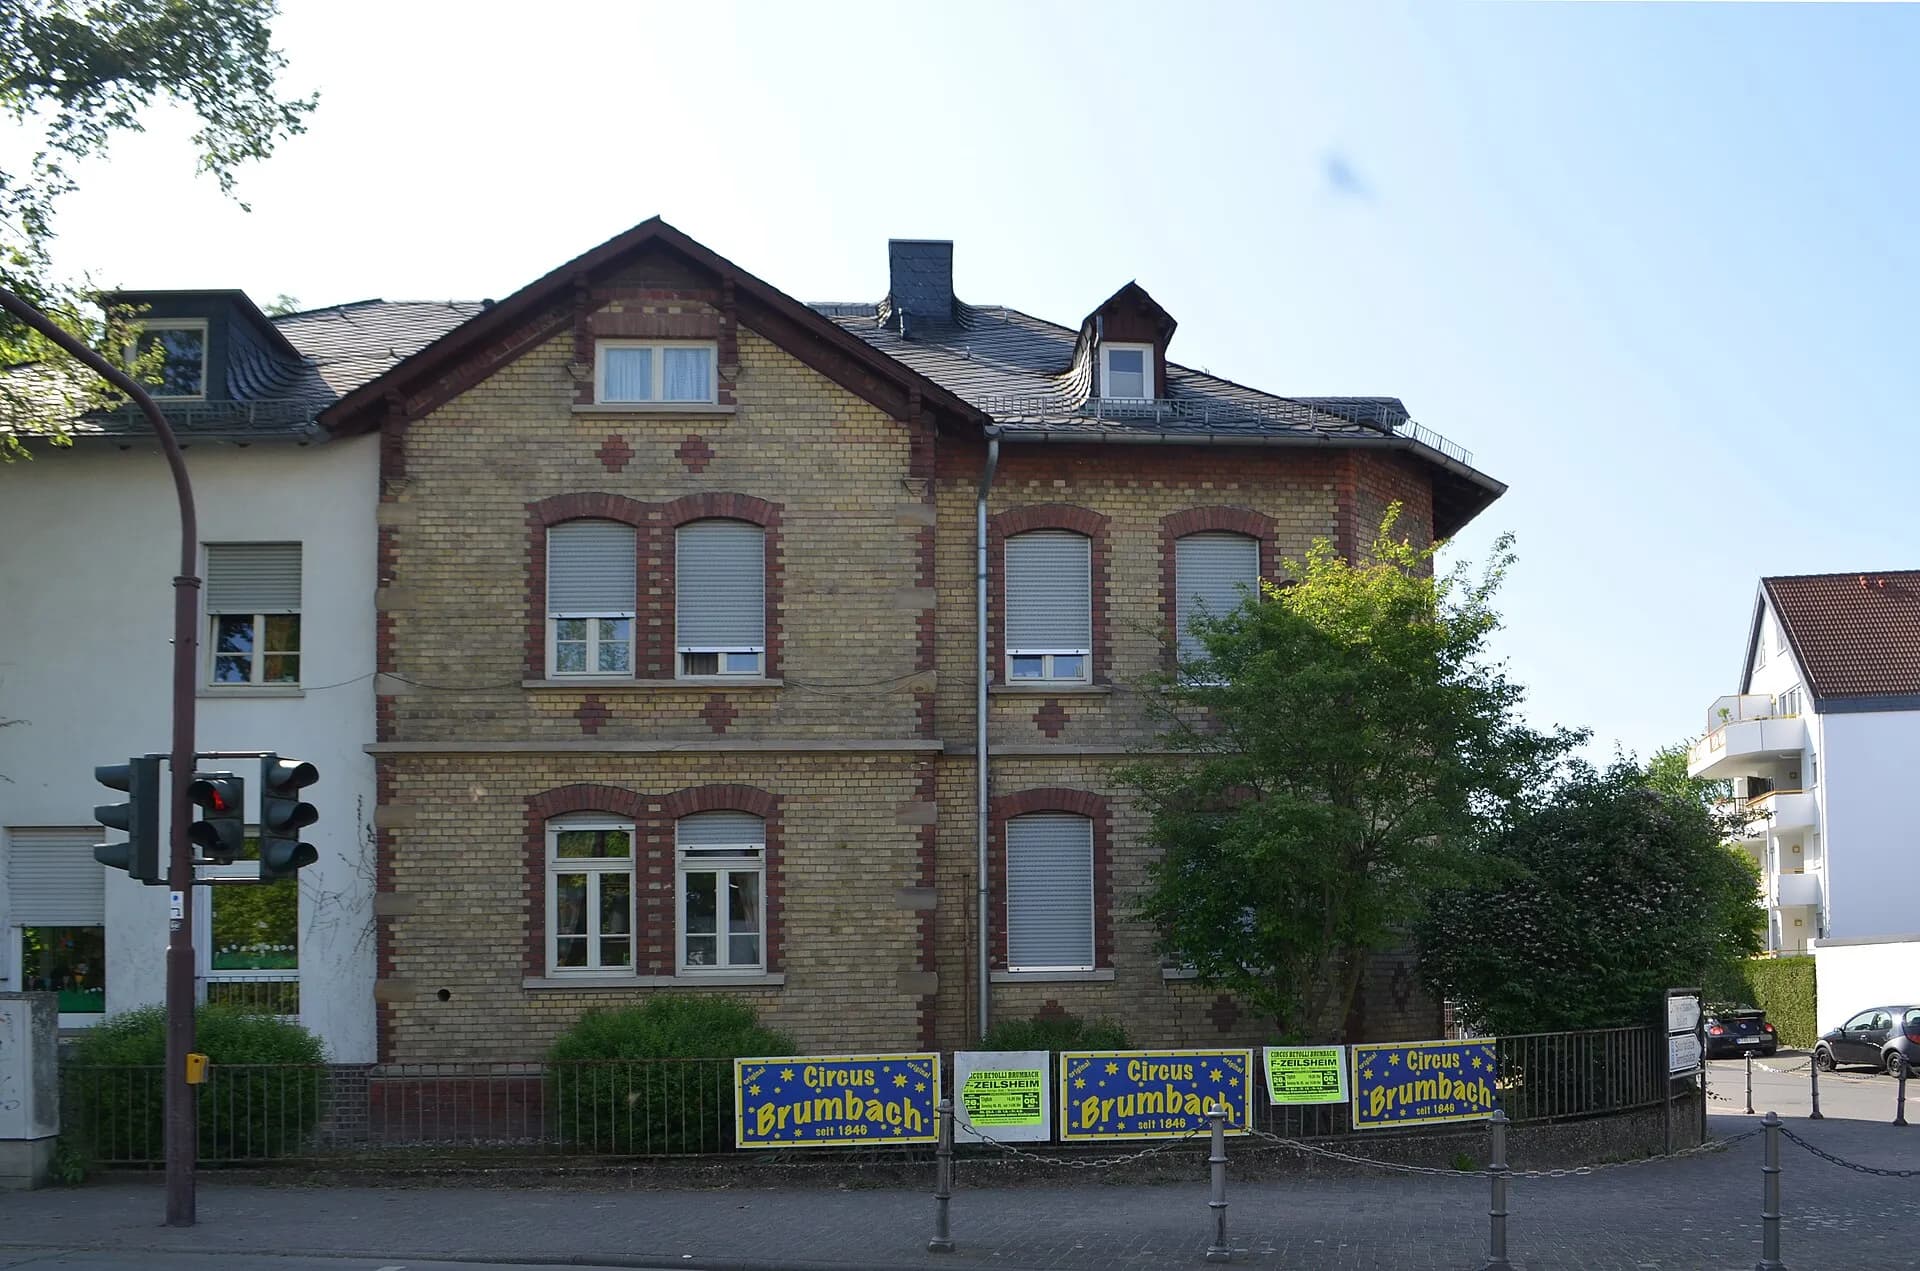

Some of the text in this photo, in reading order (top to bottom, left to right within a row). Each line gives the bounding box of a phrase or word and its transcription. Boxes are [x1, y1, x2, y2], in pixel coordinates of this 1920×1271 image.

[906, 1061, 931, 1079] original
[1068, 1059, 1091, 1078] original
[1222, 1056, 1244, 1074] original
[1271, 1059, 1337, 1067] F-ZEILSHEIM
[1407, 1050, 1460, 1071] Circus
[743, 1065, 766, 1085] original
[803, 1065, 875, 1088] Circus
[1127, 1059, 1194, 1082] Circus
[1370, 1071, 1491, 1117] Brumbach
[756, 1089, 922, 1136] Brumbach
[1416, 1103, 1455, 1115] seit 1846
[815, 1124, 868, 1137] seit 1846
[1138, 1118, 1186, 1129] seit 1846
